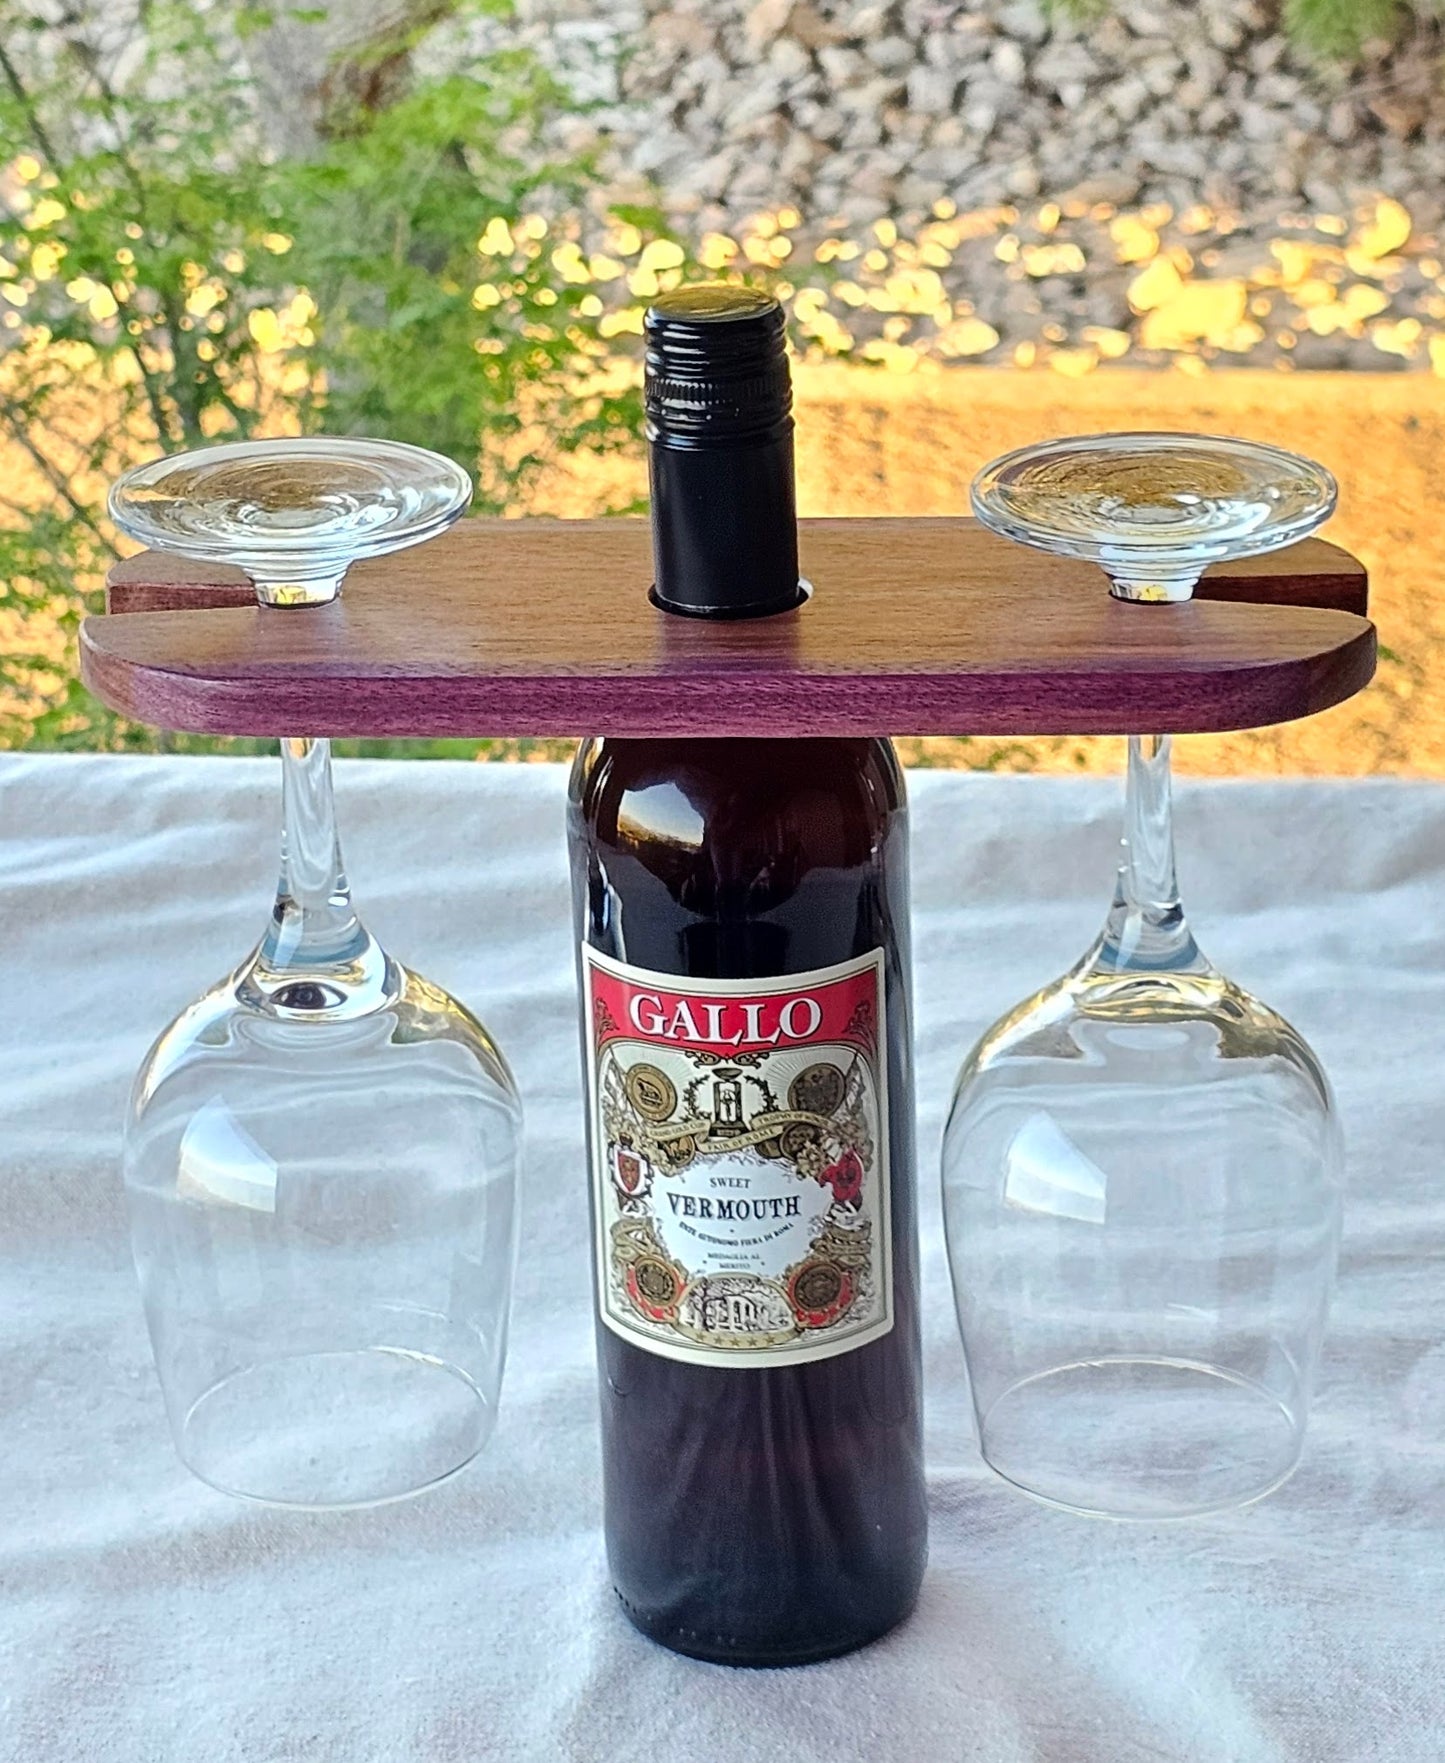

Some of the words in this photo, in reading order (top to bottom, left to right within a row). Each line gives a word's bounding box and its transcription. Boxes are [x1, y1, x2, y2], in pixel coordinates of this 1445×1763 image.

[629, 993, 822, 1046] GALLO
[709, 1177, 751, 1189] SWEET
[666, 1191, 802, 1221] VERMOUTH
